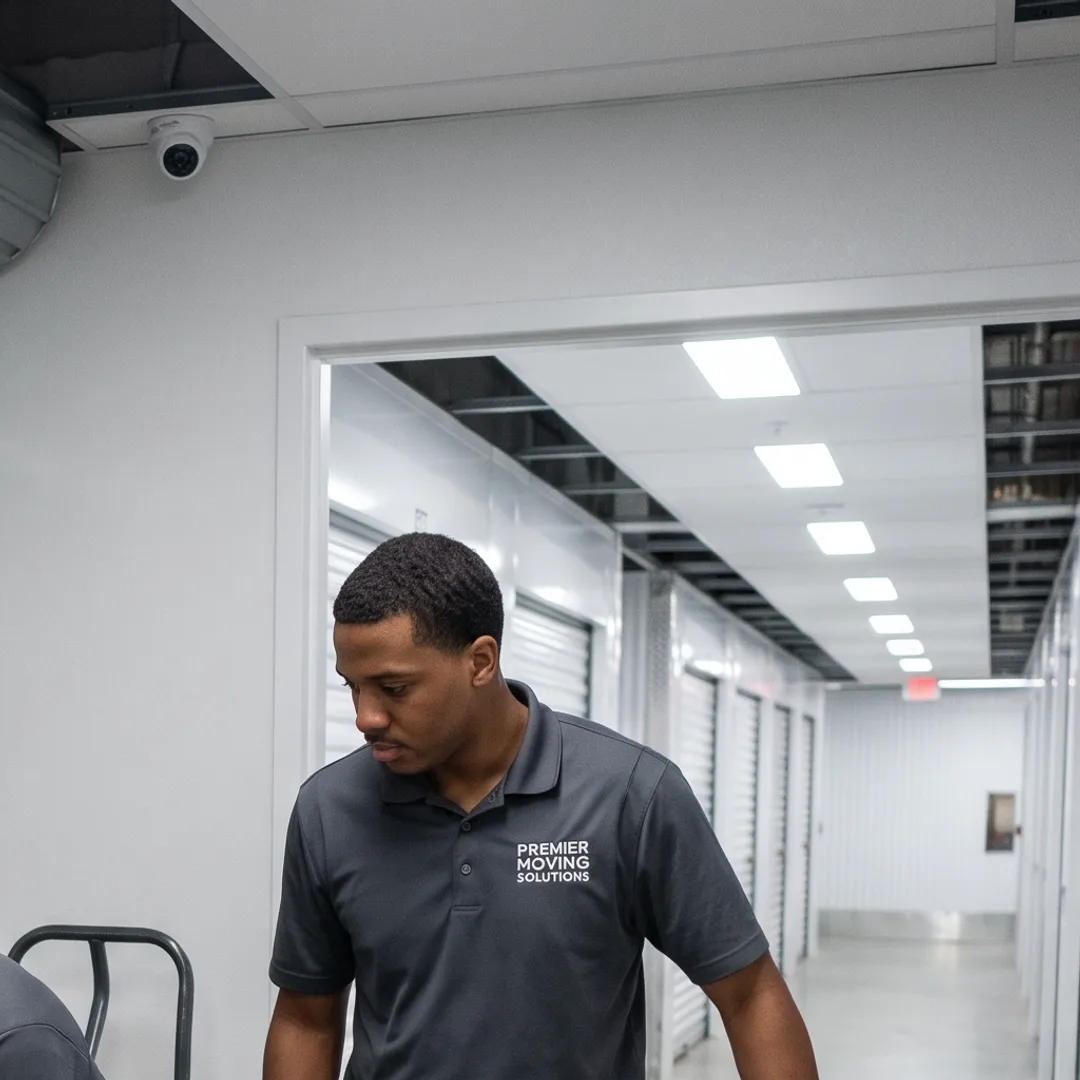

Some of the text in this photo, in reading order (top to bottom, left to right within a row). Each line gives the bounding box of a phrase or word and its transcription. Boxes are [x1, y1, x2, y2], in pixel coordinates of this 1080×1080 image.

[517, 841, 589, 857] PREMIER
[517, 856, 590, 871] MOVING
[517, 872, 590, 883] SOLUTIONS
